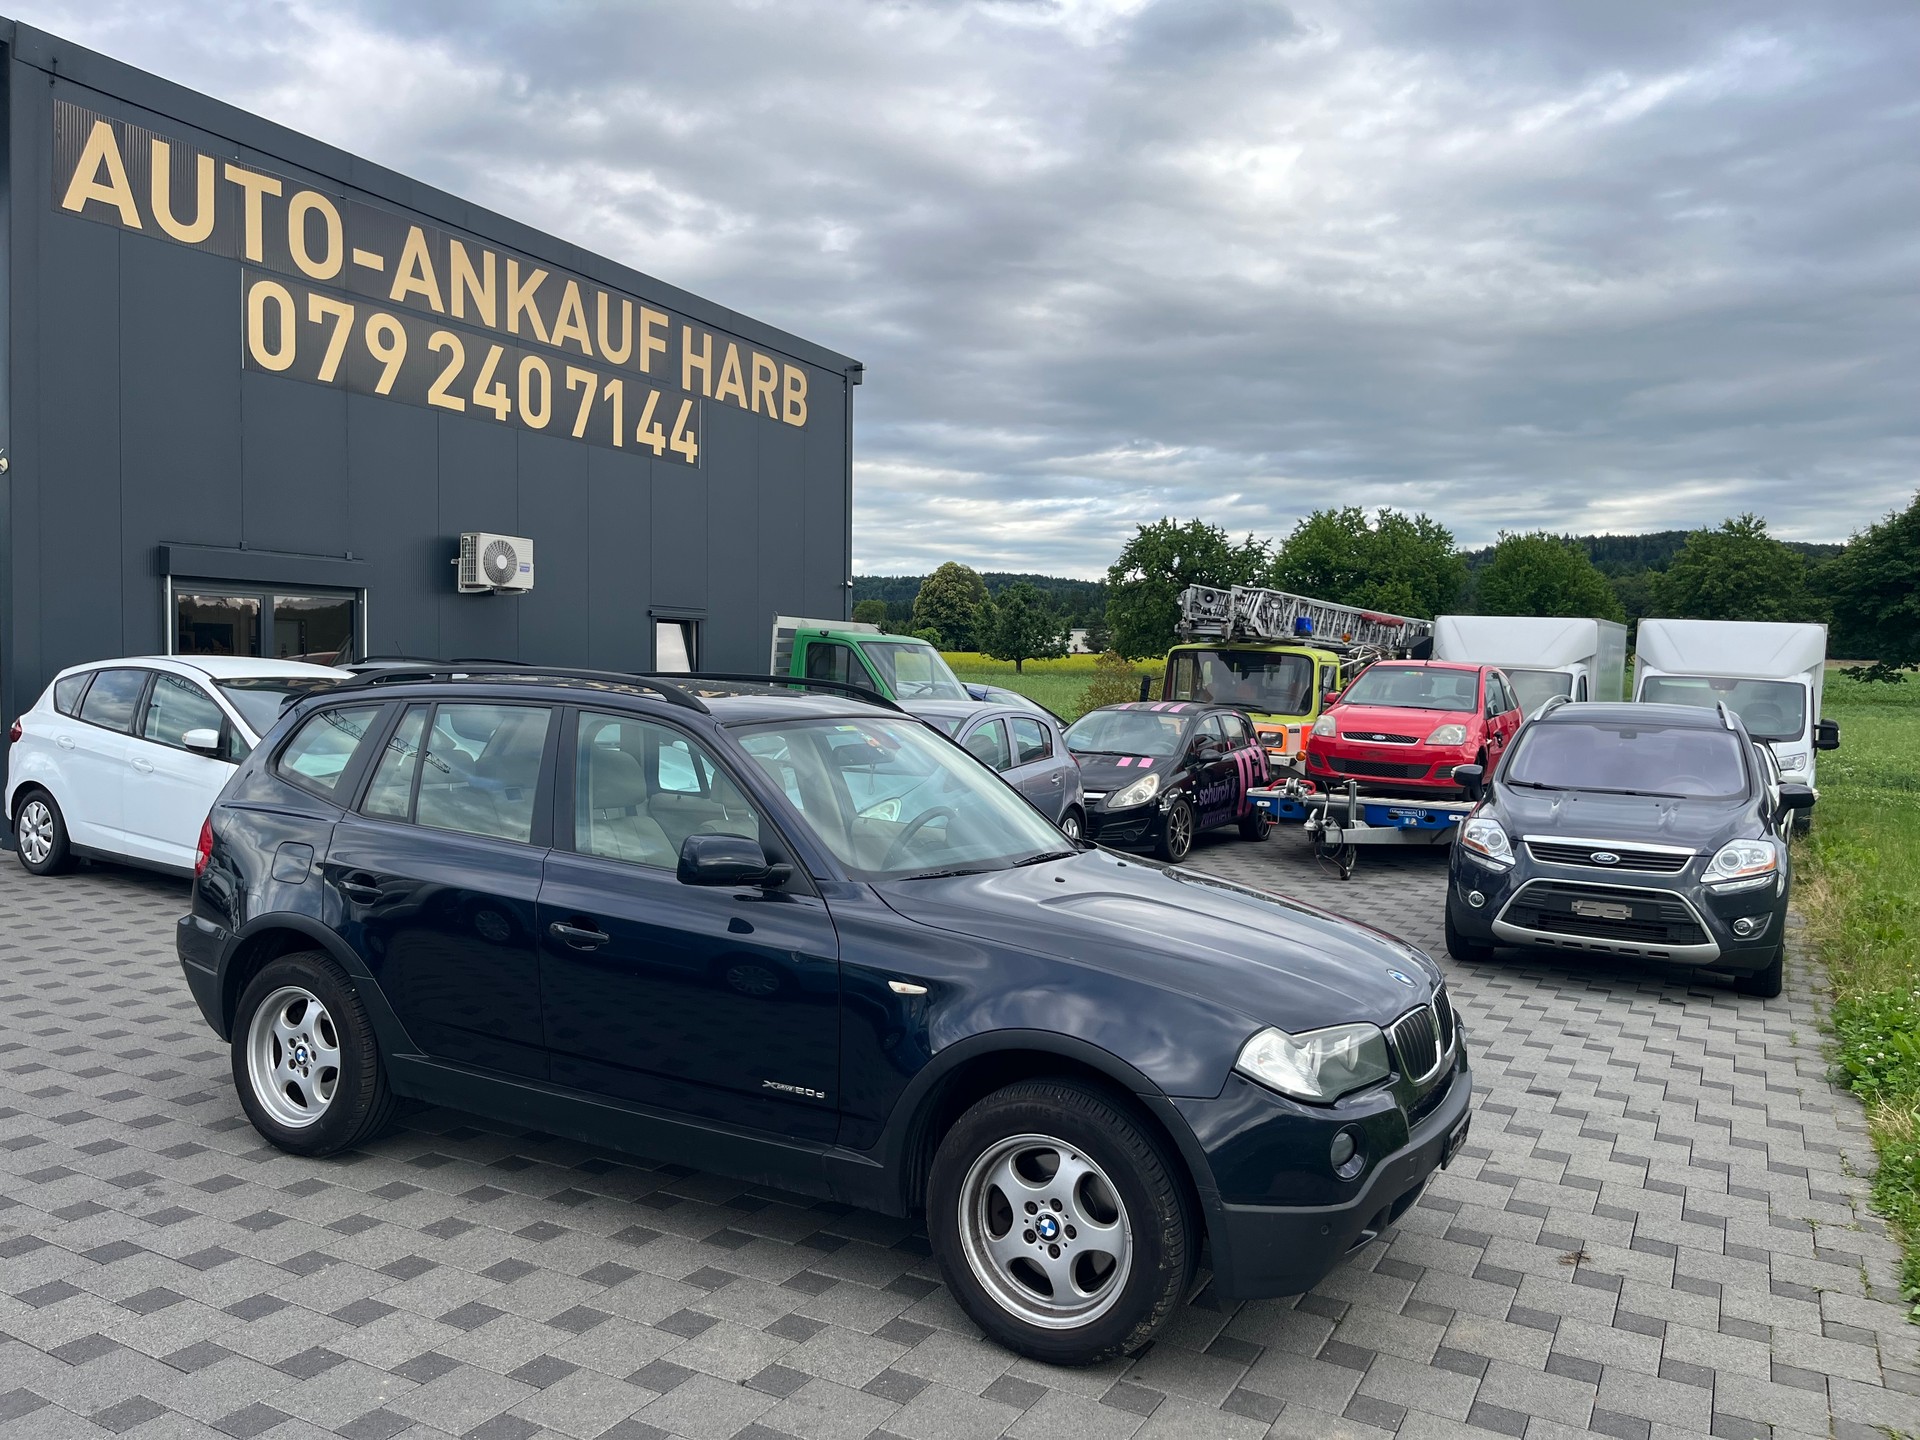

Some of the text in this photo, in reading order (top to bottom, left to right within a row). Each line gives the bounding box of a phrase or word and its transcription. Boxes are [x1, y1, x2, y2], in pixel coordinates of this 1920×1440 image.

[62, 120, 808, 428] AUTO-ANKAUF HARB
[247, 280, 408, 395] 079
[427, 330, 552, 429] 240
